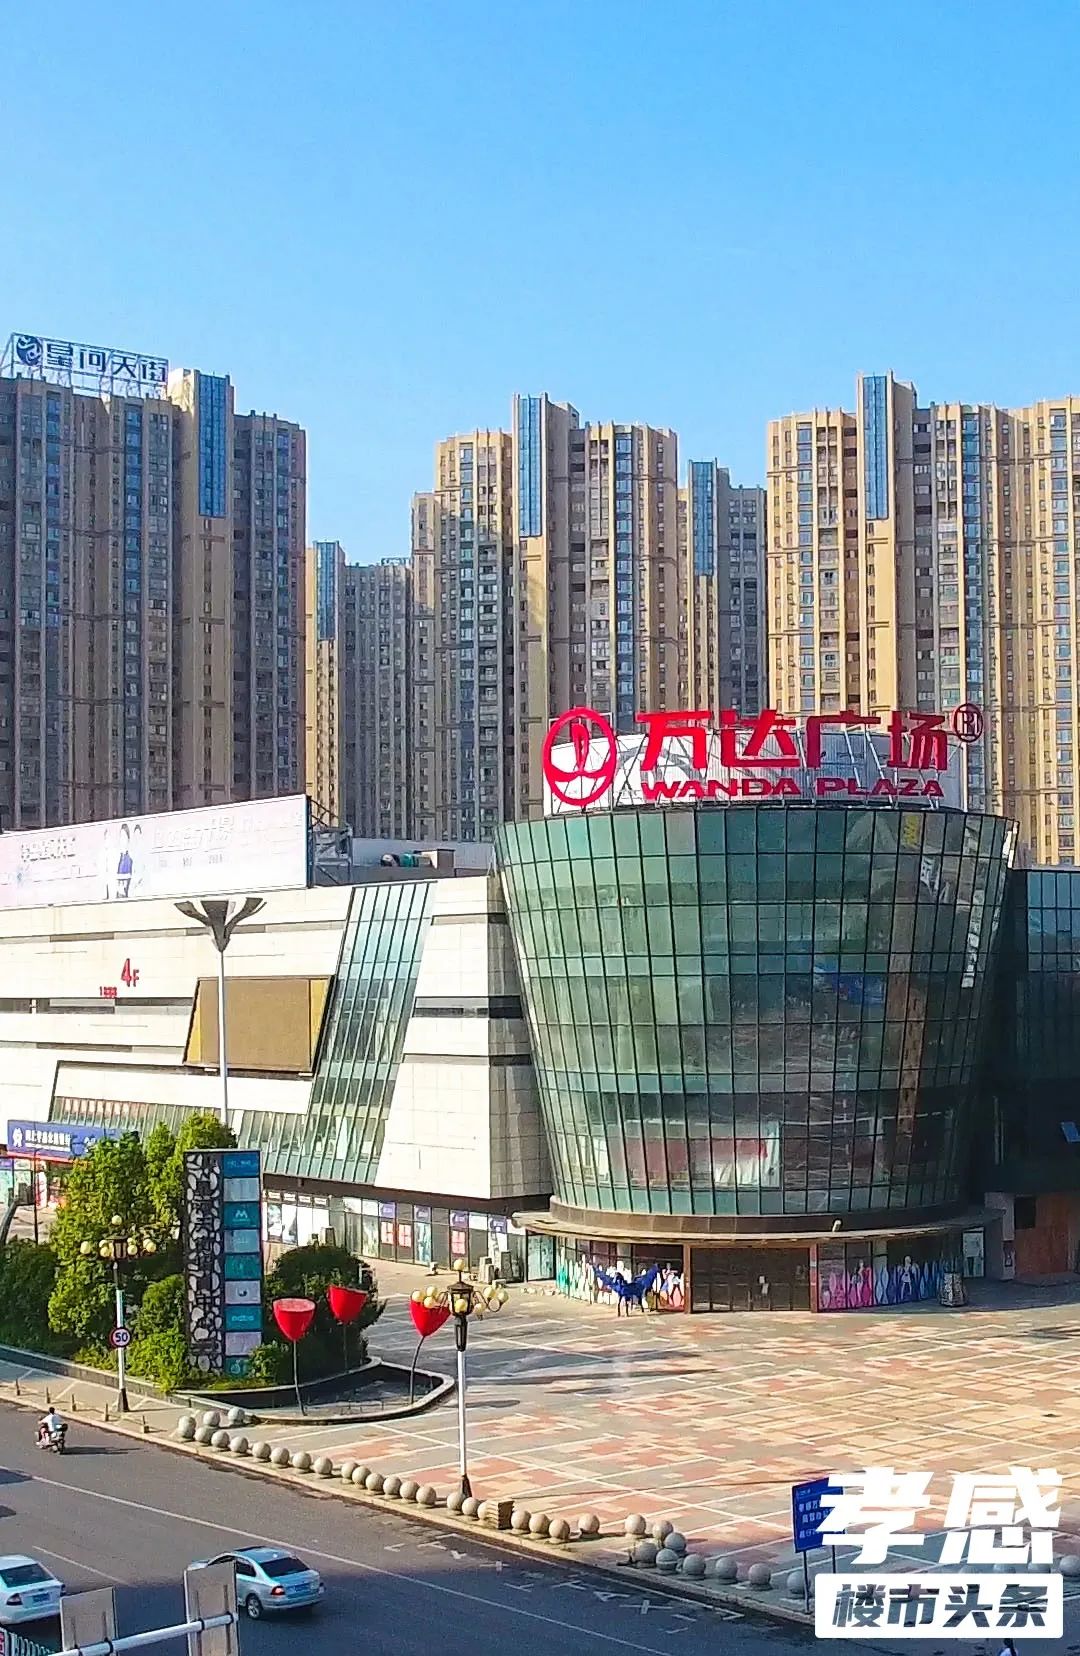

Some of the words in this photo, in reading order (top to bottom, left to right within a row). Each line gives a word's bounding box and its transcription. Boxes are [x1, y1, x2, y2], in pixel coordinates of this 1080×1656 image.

[636, 709, 947, 770] 万达广场
[641, 778, 800, 799] WANDA
[815, 777, 945, 797] PLAZA
[121, 958, 139, 987] 4F
[115, 1332, 128, 1342] 50
